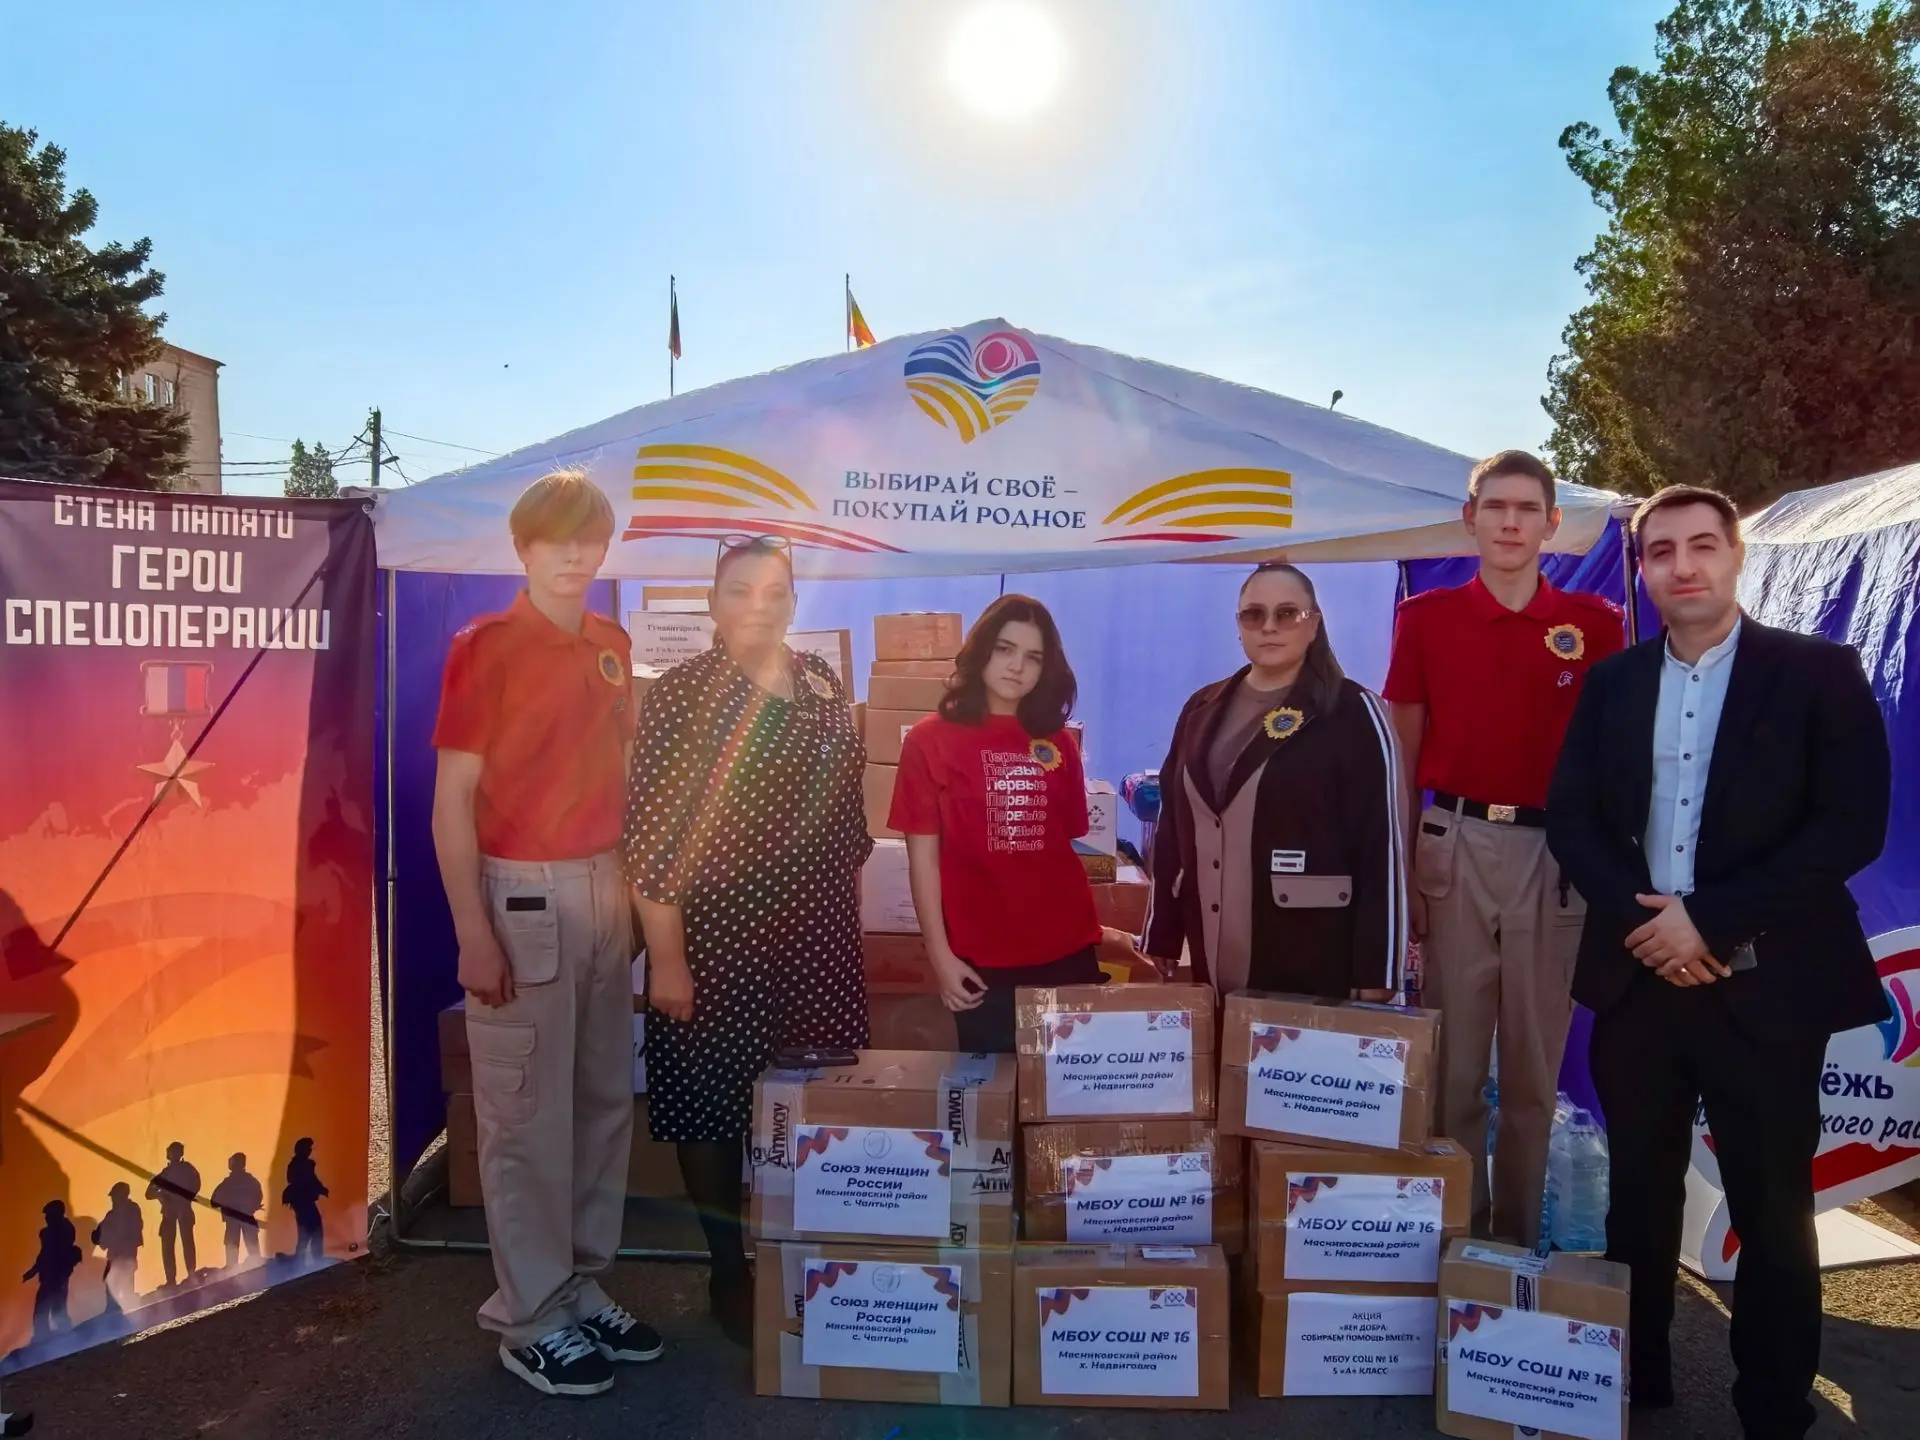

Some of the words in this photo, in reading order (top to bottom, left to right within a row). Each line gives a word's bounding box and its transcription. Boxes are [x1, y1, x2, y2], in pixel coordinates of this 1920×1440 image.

[844, 470, 978, 495] ВЫБИРАЙ
[986, 476, 1057, 499] СВОЁ
[55, 495, 155, 531] СТЕНА
[172, 504, 294, 539] ПАМЯТИ
[832, 499, 968, 523] ПОКУПАЙ
[976, 507, 1086, 529] РОДНОЕ
[112, 545, 243, 593] ГЕРОИ
[6, 599, 331, 650] СПЕЦОПЕРАЦИИ
[1056, 1053, 1104, 1065] МБОУ
[1107, 1052, 1145, 1064] СОШ
[1170, 1051, 1185, 1062] 16
[1140, 1071, 1174, 1081] район
[1258, 1067, 1307, 1083] МБОУ
[1311, 1074, 1351, 1090] СОШ
[1379, 1083, 1396, 1096] 16
[1345, 1099, 1381, 1111] район
[767, 1102, 790, 1168] Amway
[820, 1162, 861, 1174] Союз
[864, 1166, 930, 1178] женщин
[846, 1177, 903, 1190] России
[895, 1191, 928, 1202] район
[1077, 1199, 1124, 1211] МБОУ
[1128, 1196, 1165, 1209] СОШ
[1191, 1194, 1205, 1206] 16
[855, 1199, 900, 1210] Чалтырь
[1161, 1214, 1194, 1225] район
[1297, 1218, 1348, 1231] МБОУ
[1351, 1219, 1392, 1233] СОШ
[1419, 1222, 1435, 1234] 16
[1386, 1240, 1420, 1251] район
[830, 1296, 869, 1308] Союз
[873, 1299, 939, 1312] женщин
[856, 1312, 912, 1325] России
[1352, 1312, 1382, 1322] АКЦИЯ
[903, 1325, 936, 1336] район
[1051, 1330, 1102, 1342] МБОУ
[1105, 1331, 1147, 1343] СОШ
[1174, 1332, 1190, 1344] 16
[864, 1333, 909, 1344] Чалтырь
[1301, 1333, 1344, 1342] СОБИРАЕМ
[1346, 1333, 1384, 1342] ПОМОЩЬ
[1142, 1351, 1178, 1361] район
[1323, 1355, 1350, 1364] МБОУ
[1352, 1355, 1373, 1364] СОШ
[1388, 1355, 1399, 1363] 16
[1359, 1367, 1388, 1375] КЛАСС
[1459, 1347, 1514, 1368] МБОУ
[1517, 1358, 1562, 1378] СОШ
[1594, 1373, 1613, 1388] 16
[1558, 1389, 1598, 1404] район
